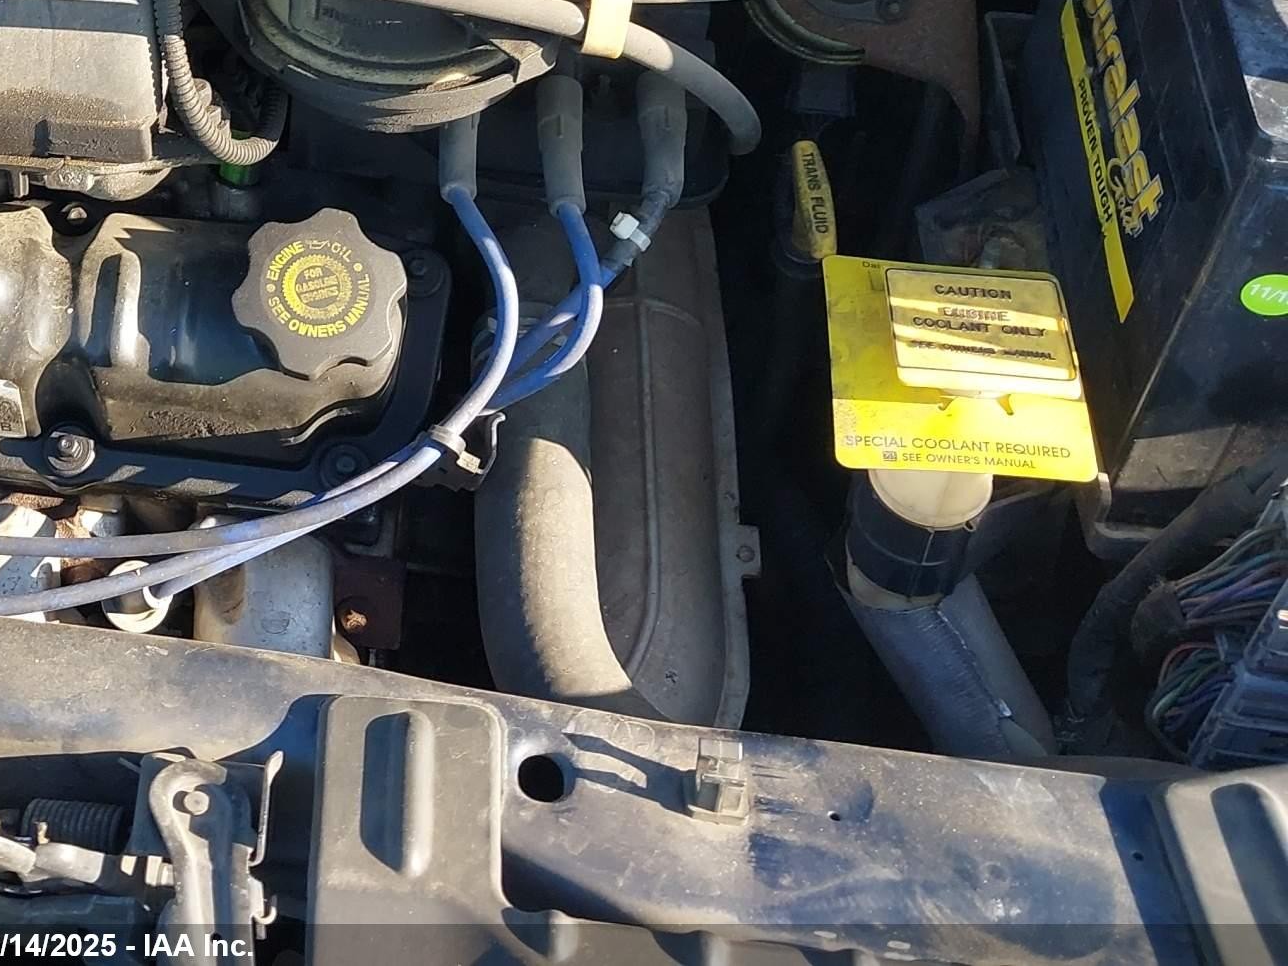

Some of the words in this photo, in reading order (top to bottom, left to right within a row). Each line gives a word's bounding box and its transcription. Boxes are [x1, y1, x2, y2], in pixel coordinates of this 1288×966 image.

[1076, 78, 1101, 157] PROVEN
[1092, 148, 1113, 223] TOUGH
[802, 152, 821, 191] TRANS
[810, 196, 829, 234] FLUID
[268, 240, 306, 281] ENGINE
[330, 241, 354, 263] OIL
[304, 267, 323, 280] FOR
[267, 296, 291, 324] SEE
[288, 319, 347, 338] OWNERS
[344, 273, 370, 326] MANUAL
[934, 284, 1013, 300] CAUTION
[912, 316, 993, 333] COOLANT
[1001, 324, 1047, 337] ONLY
[844, 434, 907, 449] SPECIAL
[911, 437, 990, 453] COOLANT
[995, 442, 1071, 459] REQUIRED
[901, 452, 922, 462] SEE
[926, 453, 980, 465] OWNER'S
[984, 457, 1037, 469] MANUAL
